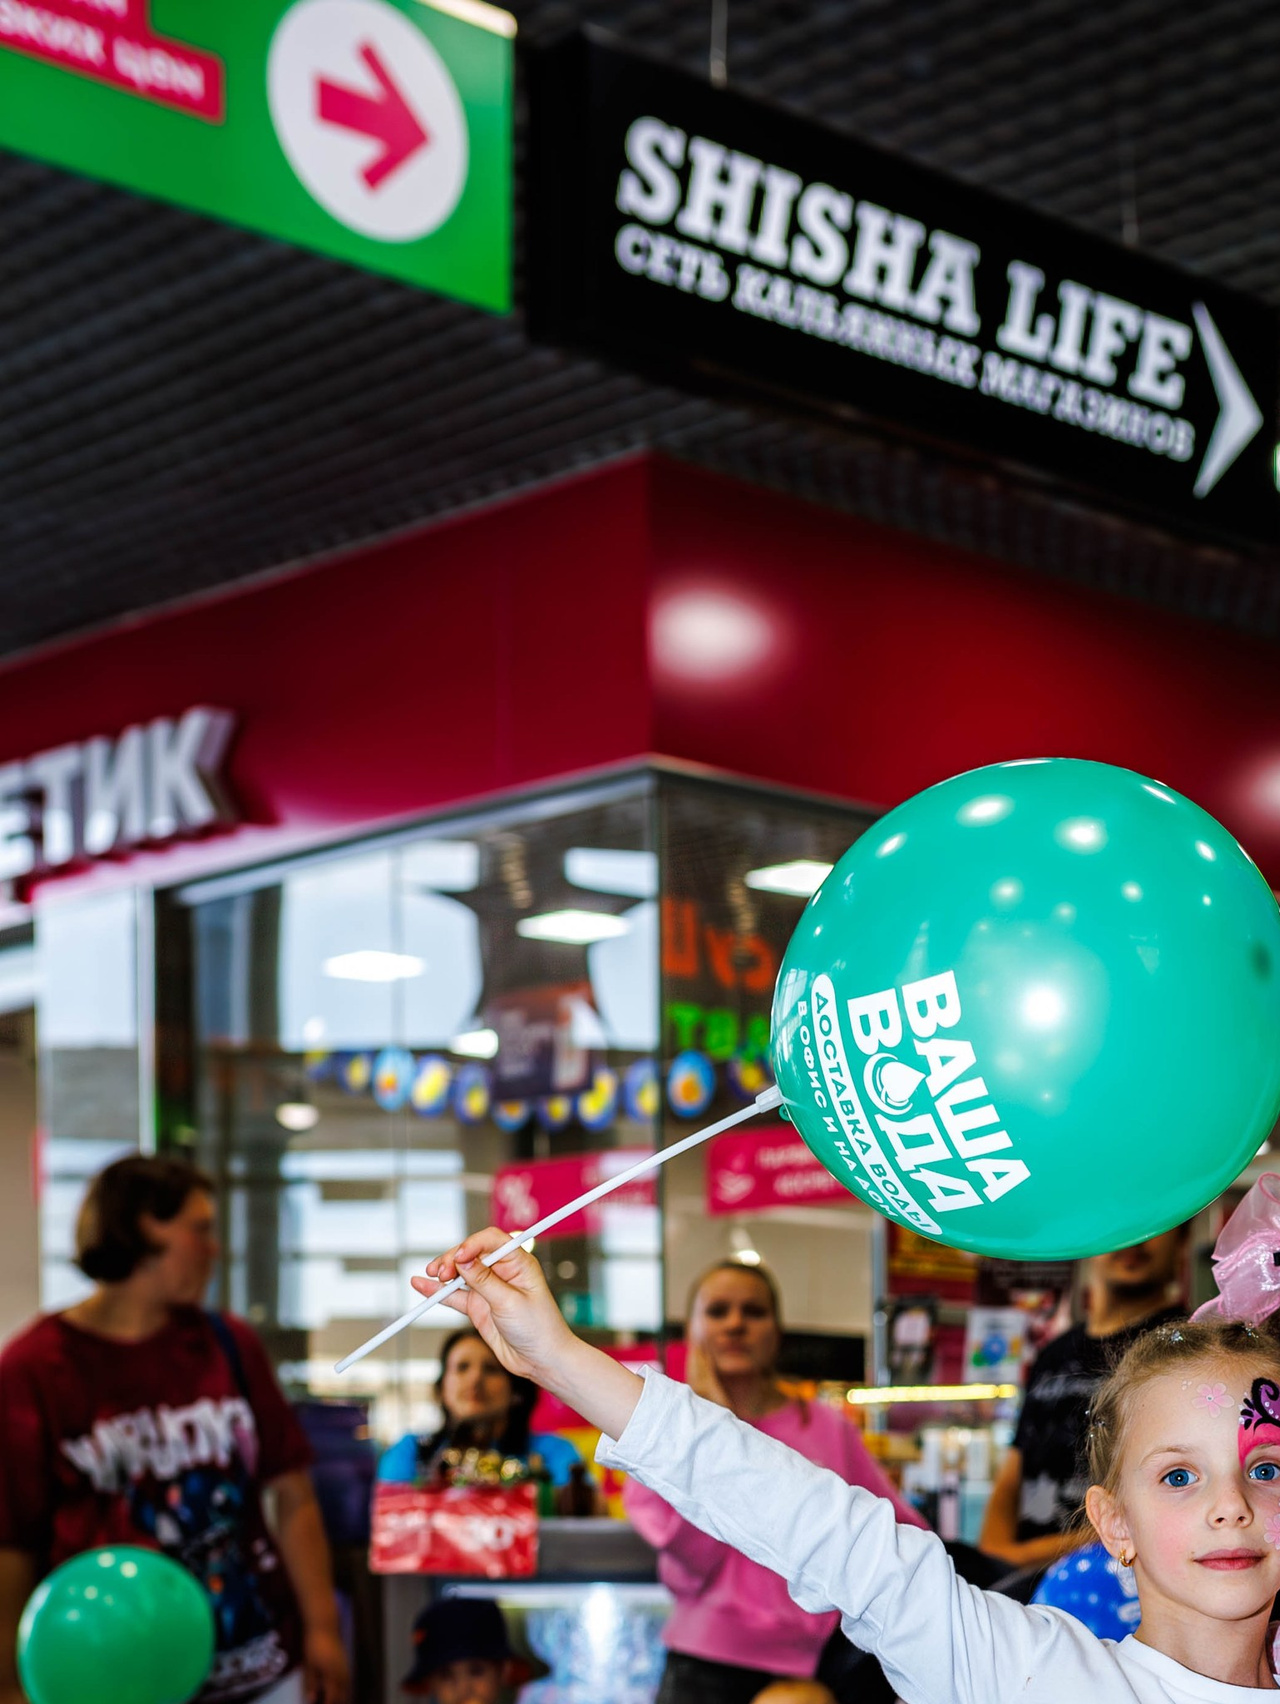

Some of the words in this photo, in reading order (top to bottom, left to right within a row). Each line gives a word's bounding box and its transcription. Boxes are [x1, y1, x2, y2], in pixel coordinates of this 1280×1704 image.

[614, 222, 730, 302] СЕТЬ
[731, 263, 981, 389] КАЛЬЯННЫХ
[978, 351, 1196, 462] МАГАЗИНОВ
[616, 115, 981, 337] SHISHA
[996, 259, 1194, 409] LIFE
[800, 1025, 828, 1109] ОФИС
[822, 1116, 839, 1133] И
[834, 1140, 857, 1171] НА
[855, 1175, 899, 1217] ДОМ
[815, 992, 872, 1156] ДОСТАВКА
[870, 1164, 932, 1228] ВОДЫ
[847, 988, 985, 1213] ВОДА
[901, 970, 1031, 1202] ВАША
